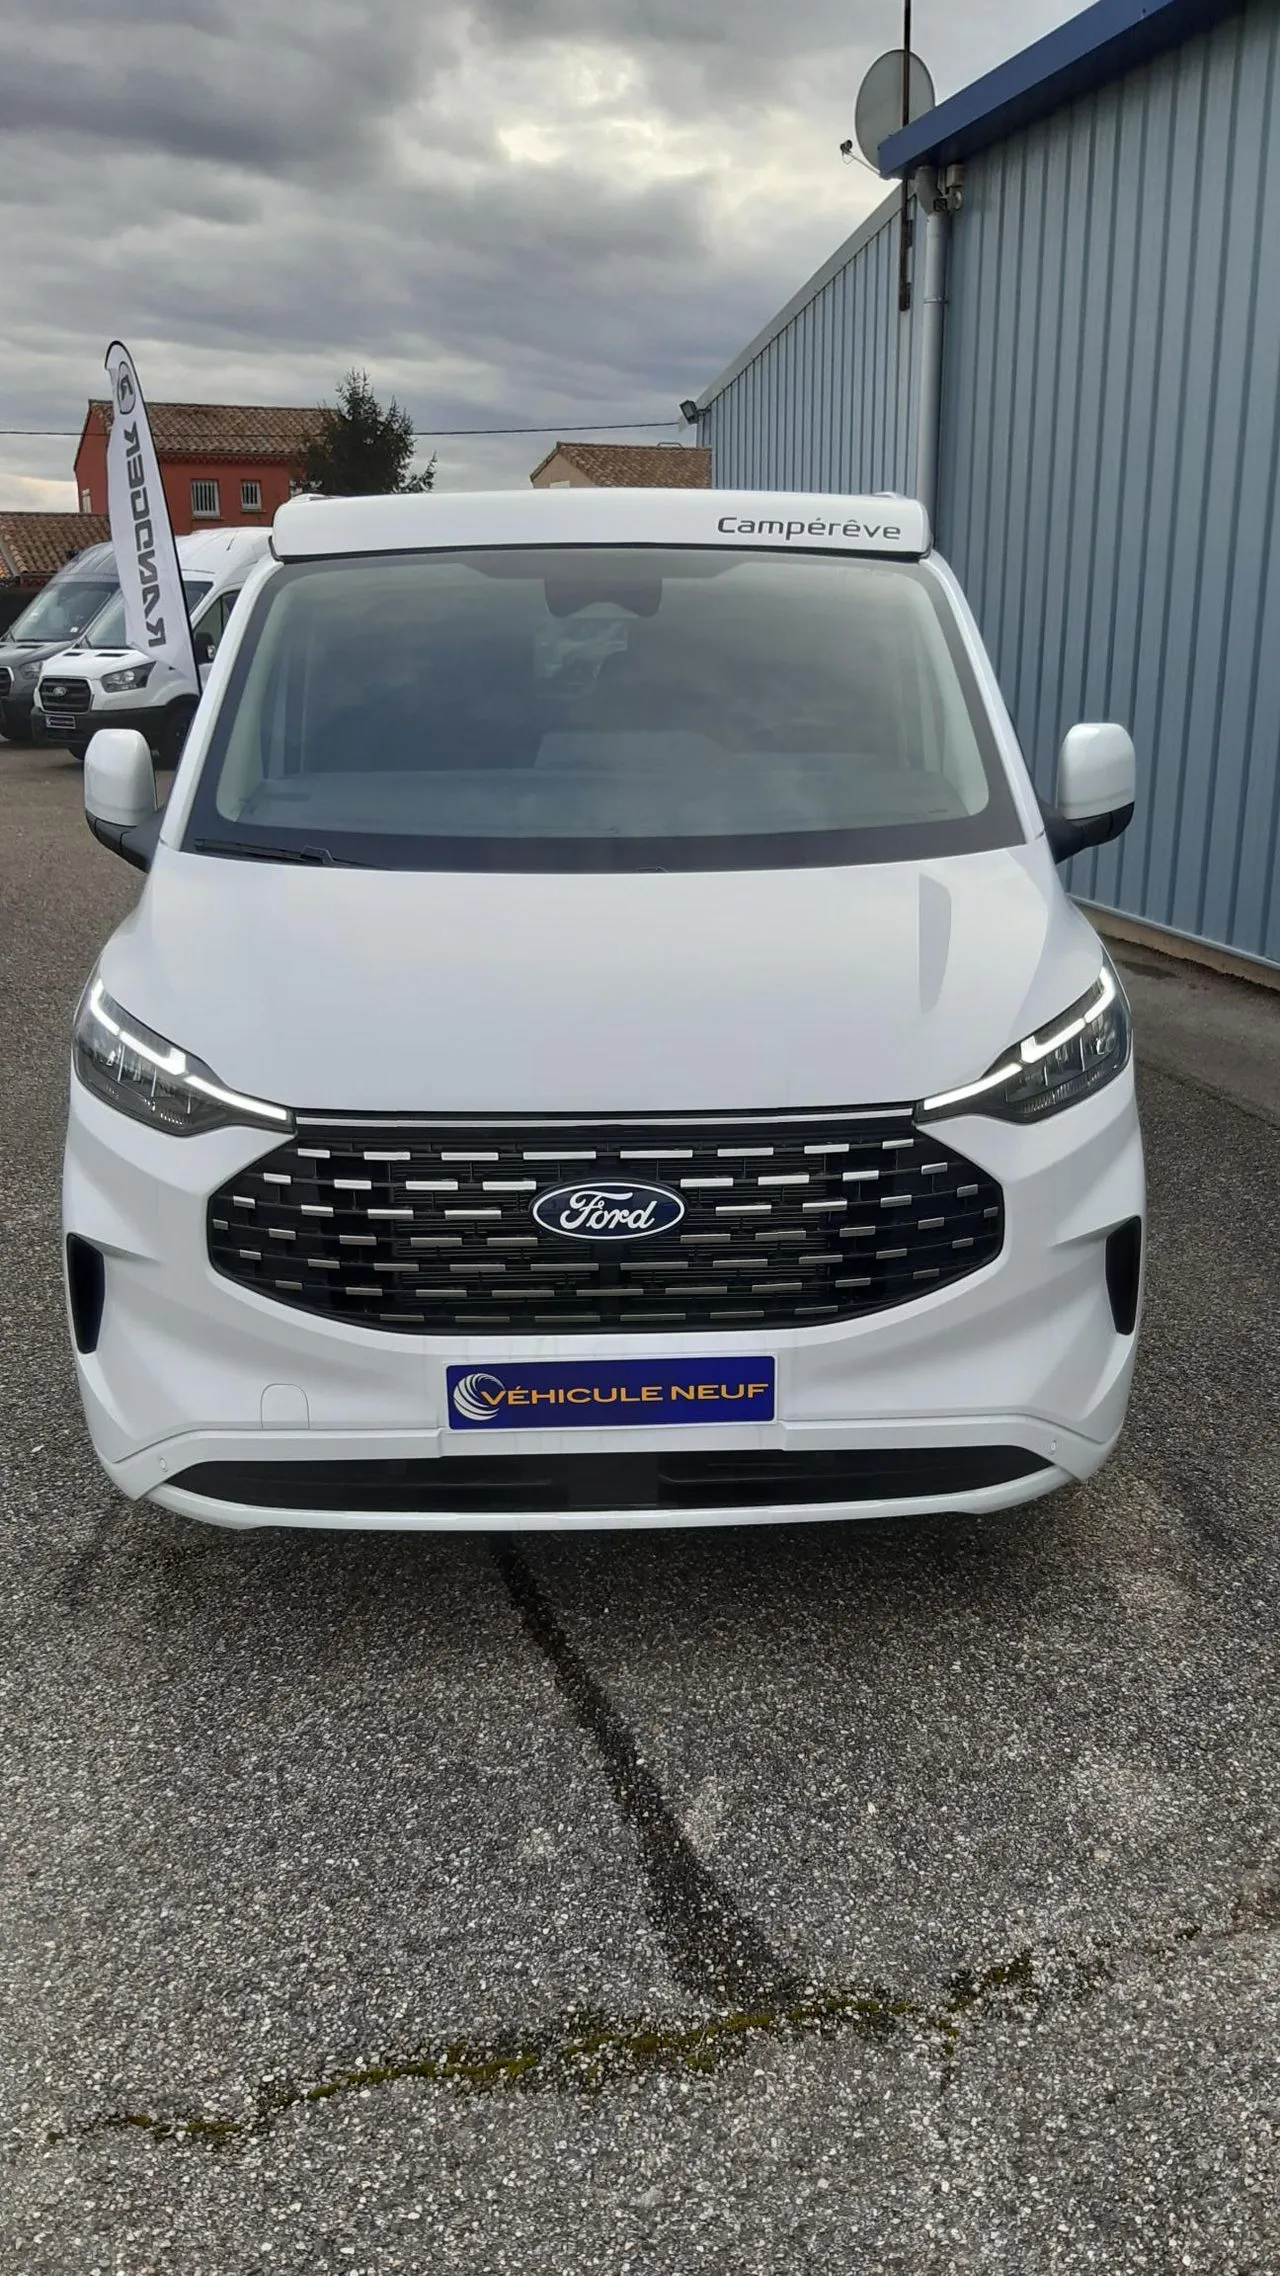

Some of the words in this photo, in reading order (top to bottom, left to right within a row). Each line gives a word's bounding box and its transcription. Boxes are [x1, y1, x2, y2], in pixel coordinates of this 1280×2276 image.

[717, 517, 901, 541] Campérêve
[559, 1190, 658, 1230] Ford
[480, 1385, 664, 1406] VÉHICULE
[670, 1383, 769, 1400] NEUF
